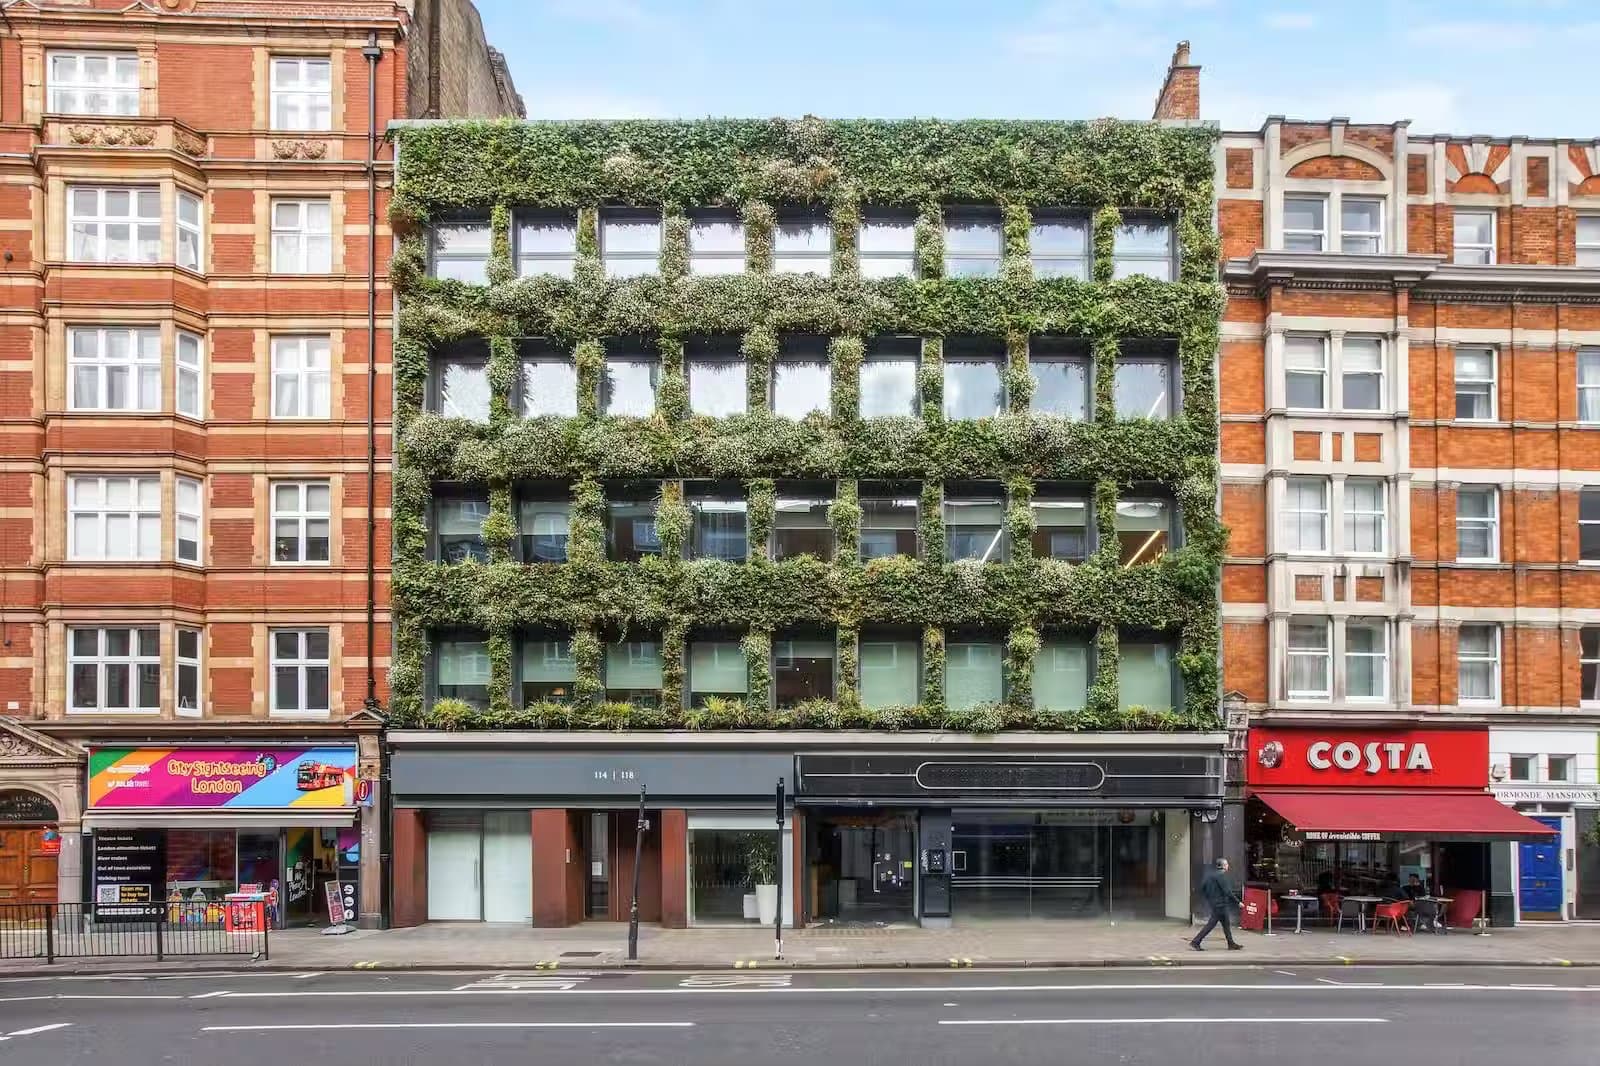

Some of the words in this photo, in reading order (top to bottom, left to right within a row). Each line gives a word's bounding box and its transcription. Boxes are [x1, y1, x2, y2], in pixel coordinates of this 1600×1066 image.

[1307, 741, 1433, 774] COSTA
[167, 759, 193, 777] City
[191, 760, 267, 778] Sightseeing
[594, 771, 608, 779] 114
[621, 771, 634, 779] 118
[191, 778, 244, 794] London
[1496, 791, 1541, 800] ORMONDE
[1546, 791, 1593, 800] MANSIONS
